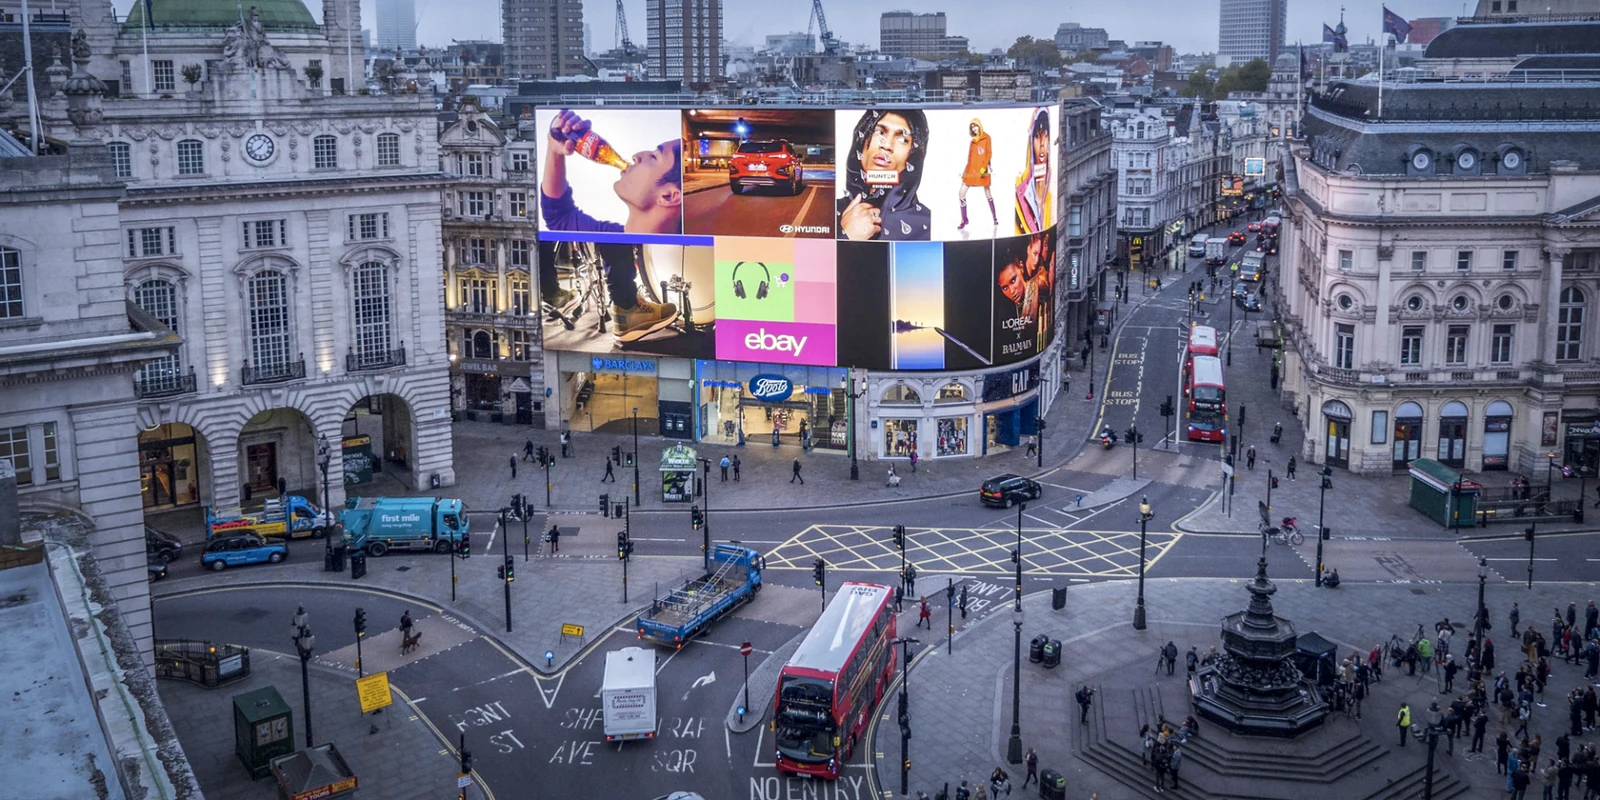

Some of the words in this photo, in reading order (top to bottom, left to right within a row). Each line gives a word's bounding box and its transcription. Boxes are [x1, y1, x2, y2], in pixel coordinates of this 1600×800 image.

[744, 328, 808, 357] ebay
[1002, 339, 1032, 354] BALMAIN
[460, 362, 482, 371] JEWEL
[482, 363, 498, 372] BAR
[604, 359, 656, 372] BARCLAYS
[753, 378, 788, 397] Boots
[1012, 369, 1029, 394] GAP
[381, 514, 400, 522] first
[401, 514, 420, 522] mile
[817, 711, 826, 719] 14
[489, 729, 525, 754] ST
[549, 740, 601, 764] AVE
[750, 777, 781, 800] NO
